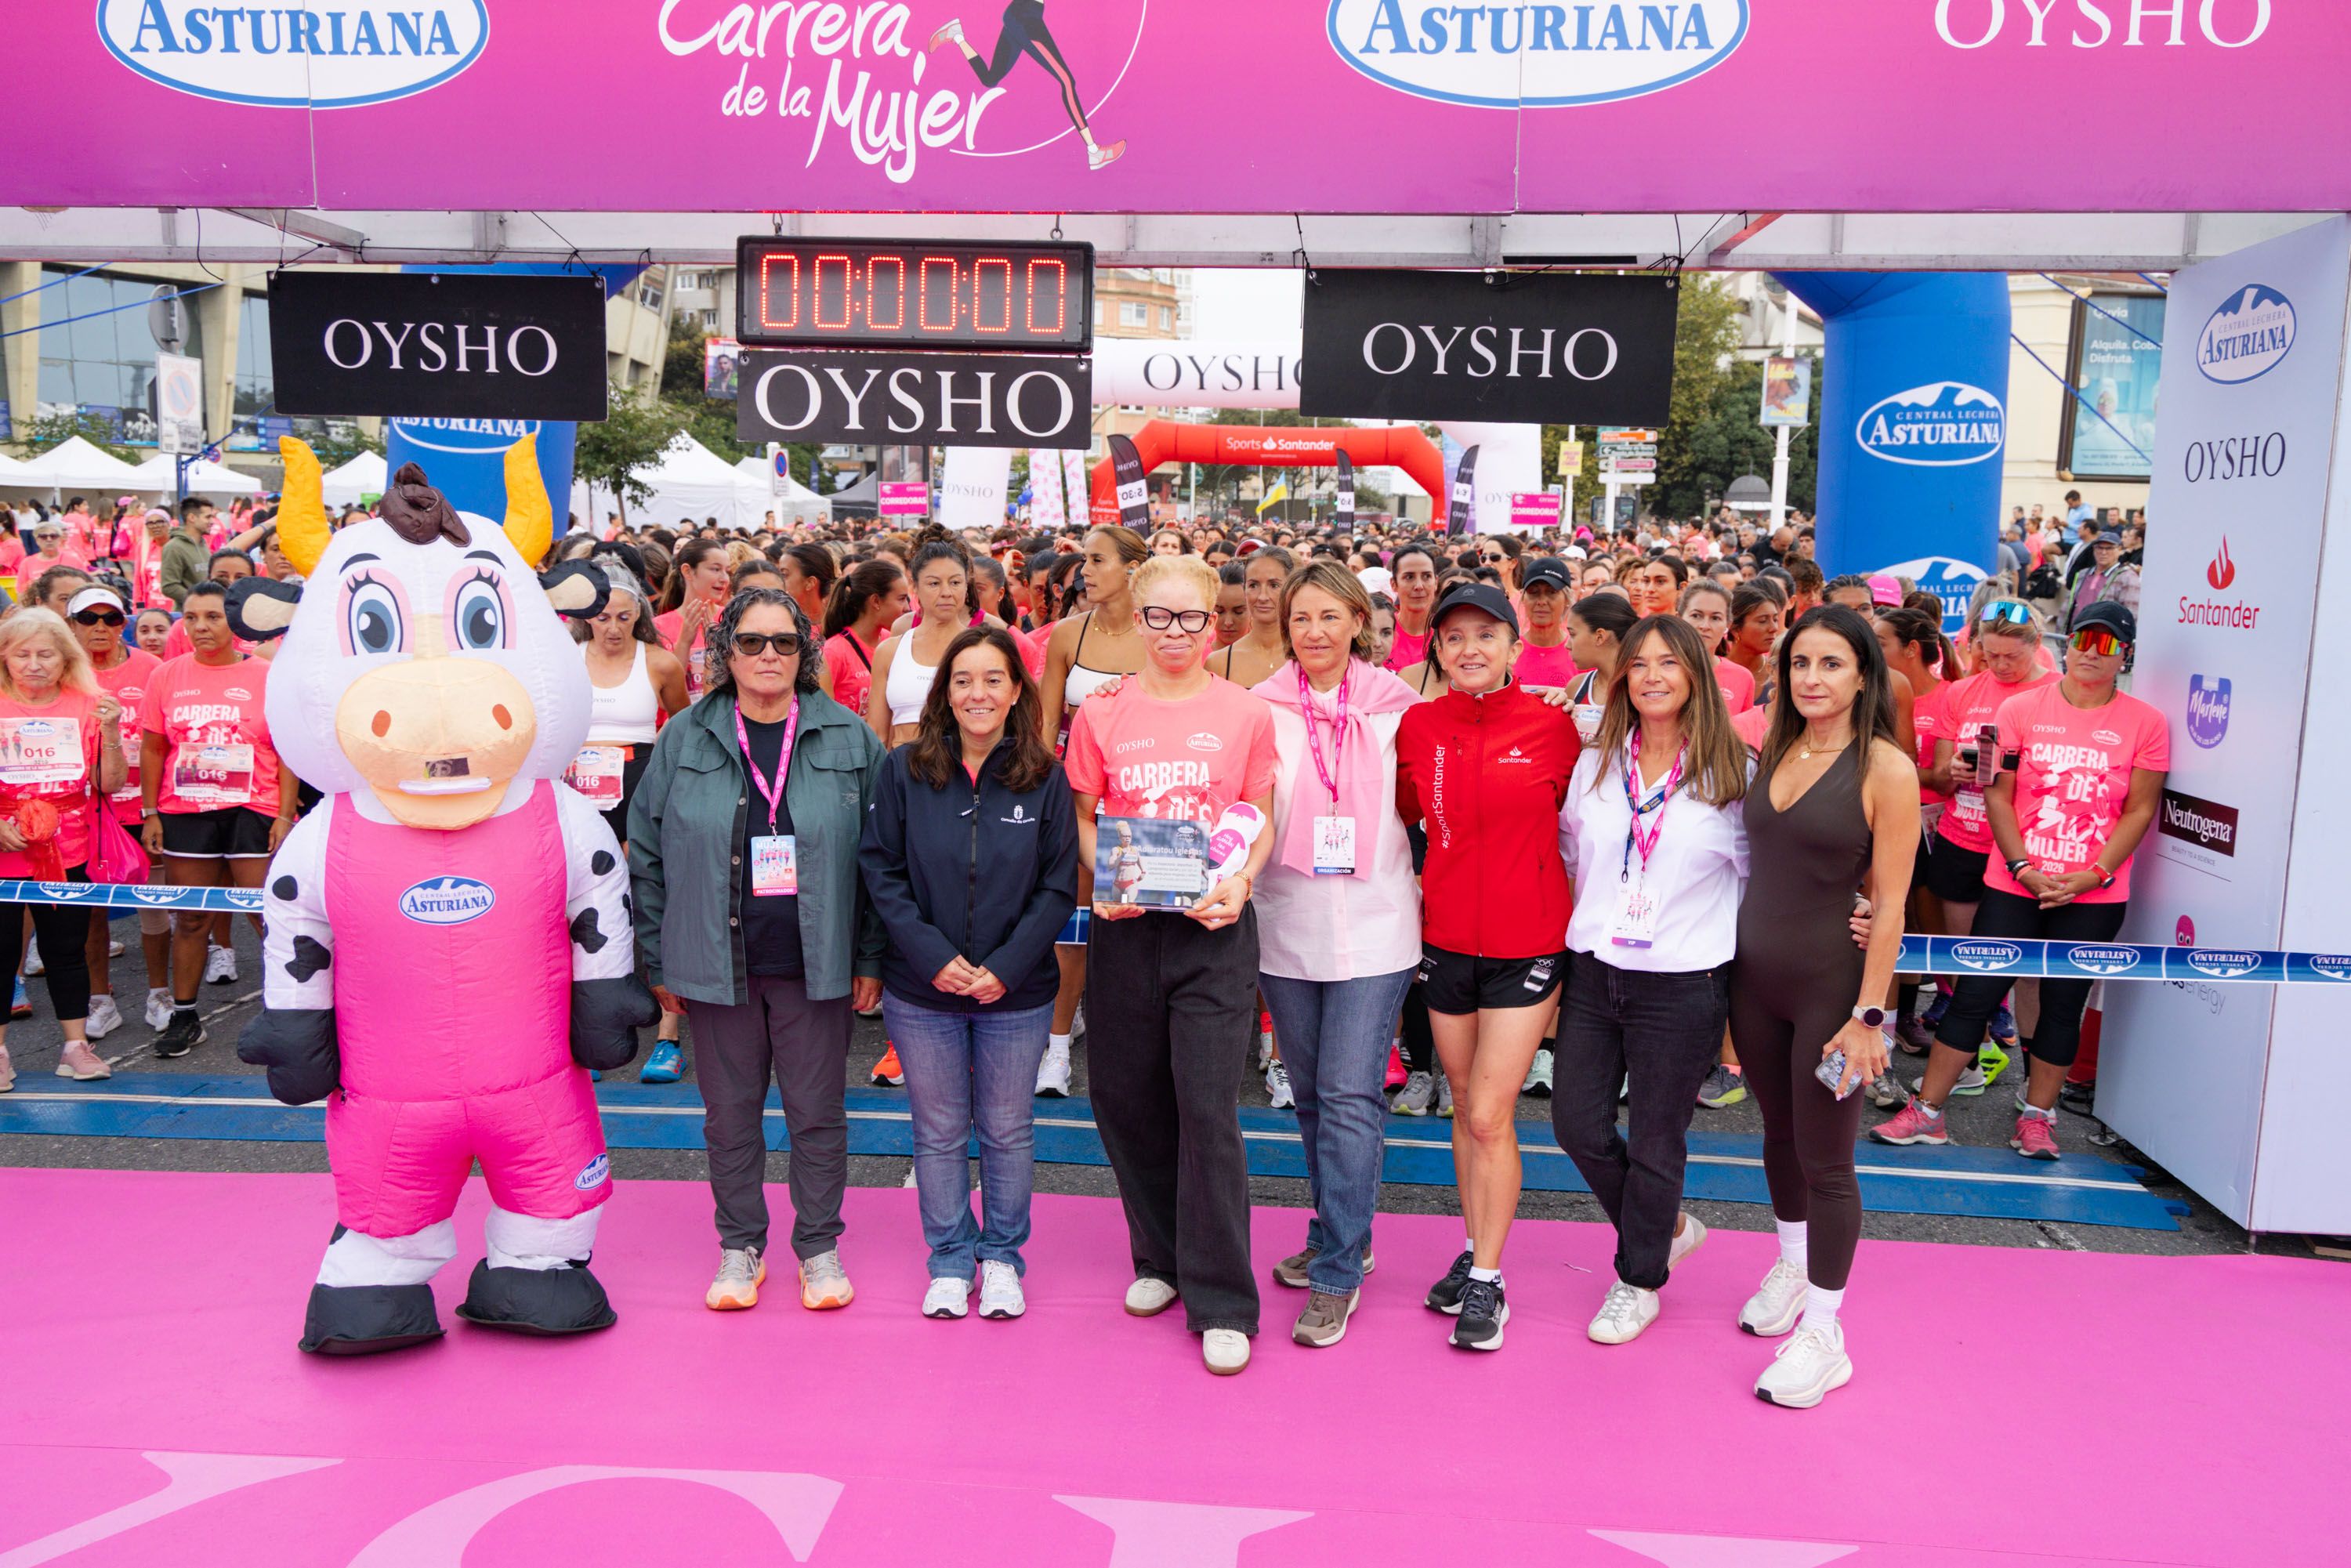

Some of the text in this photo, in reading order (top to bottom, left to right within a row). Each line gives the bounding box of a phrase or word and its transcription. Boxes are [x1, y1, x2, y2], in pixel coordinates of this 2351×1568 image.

[129, 0, 461, 56] ASTURIANA
[658, 0, 913, 58] Carrera
[1359, 0, 1714, 55] ASTURIANA
[1934, 0, 2271, 49] OYSHO
[721, 50, 1007, 184] de la Mujer
[762, 254, 1065, 333] 00:00:00
[324, 319, 557, 376] OYSHO
[1363, 323, 1618, 381] OYSHO
[2202, 324, 2287, 365] ASTURIANA
[1143, 353, 1301, 392] OYSH
[755, 364, 1074, 437] OYSHO
[1896, 411, 1954, 421] CENTRAL
[1226, 437, 1335, 451] Sports Santander
[1867, 414, 1999, 446] ASTURIANA
[2185, 433, 2286, 483] OYSHO
[947, 483, 993, 498] OYSHO
[2178, 596, 2260, 629] Santander
[2189, 690, 2228, 727] Marlene
[2032, 723, 2067, 734] OYSHO
[24, 747, 56, 759] 016
[1117, 737, 1155, 754] OYSHO
[198, 770, 228, 780] 016
[576, 776, 600, 788] 016
[1120, 761, 1211, 792] CARRERA
[1433, 744, 1451, 849] #SportSantander
[2164, 798, 2230, 842] Neutrogena
[2025, 836, 2088, 864] MUJER
[2041, 860, 2065, 874] 2026
[408, 895, 488, 912] ASTURIANA
[1958, 946, 2017, 961] ASTURIANA
[2074, 949, 2135, 964] ASTURIANA
[2193, 953, 2256, 967] ASTURIANA
